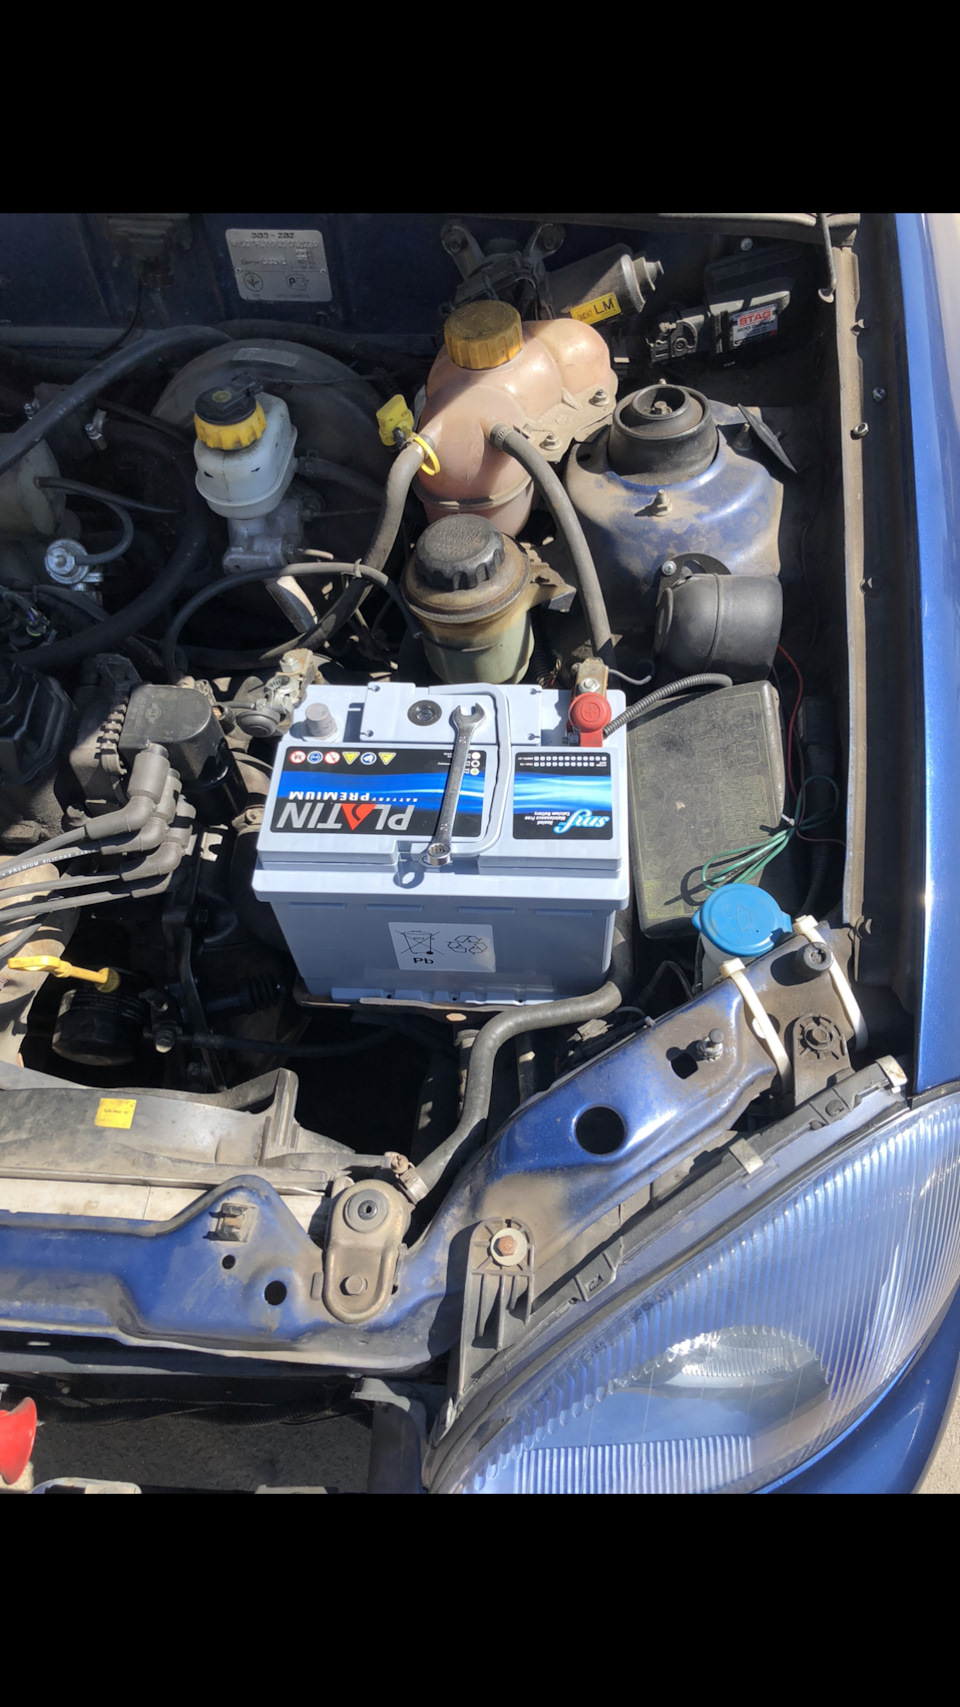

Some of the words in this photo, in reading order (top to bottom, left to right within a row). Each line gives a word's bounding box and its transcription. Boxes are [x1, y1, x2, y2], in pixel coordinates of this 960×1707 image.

[593, 298, 614, 315] LM
[739, 309, 771, 326] STAG
[289, 790, 371, 801] PREMIUM
[276, 802, 416, 831] PLATIN
[553, 808, 610, 834] smf
[8, 861, 39, 875] PREMIUM
[42, 853, 72, 864] SILICONE
[413, 957, 434, 965] Pb
